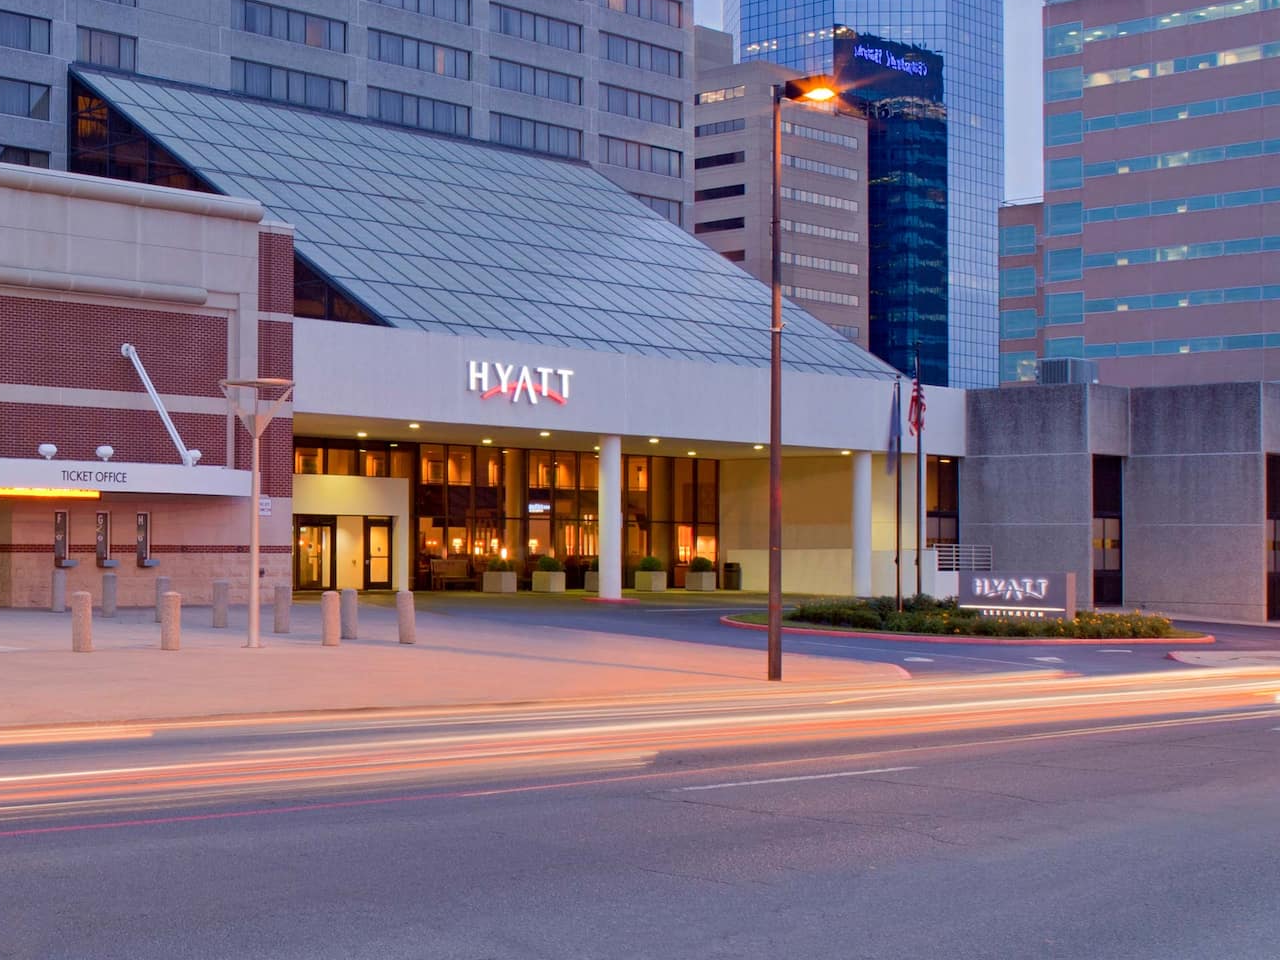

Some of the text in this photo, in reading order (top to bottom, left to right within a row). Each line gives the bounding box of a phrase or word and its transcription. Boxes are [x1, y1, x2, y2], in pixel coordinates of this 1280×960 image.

[467, 360, 574, 404] HYATT
[61, 470, 128, 483] TICKET OFFICE
[973, 578, 1049, 600] HYATT
